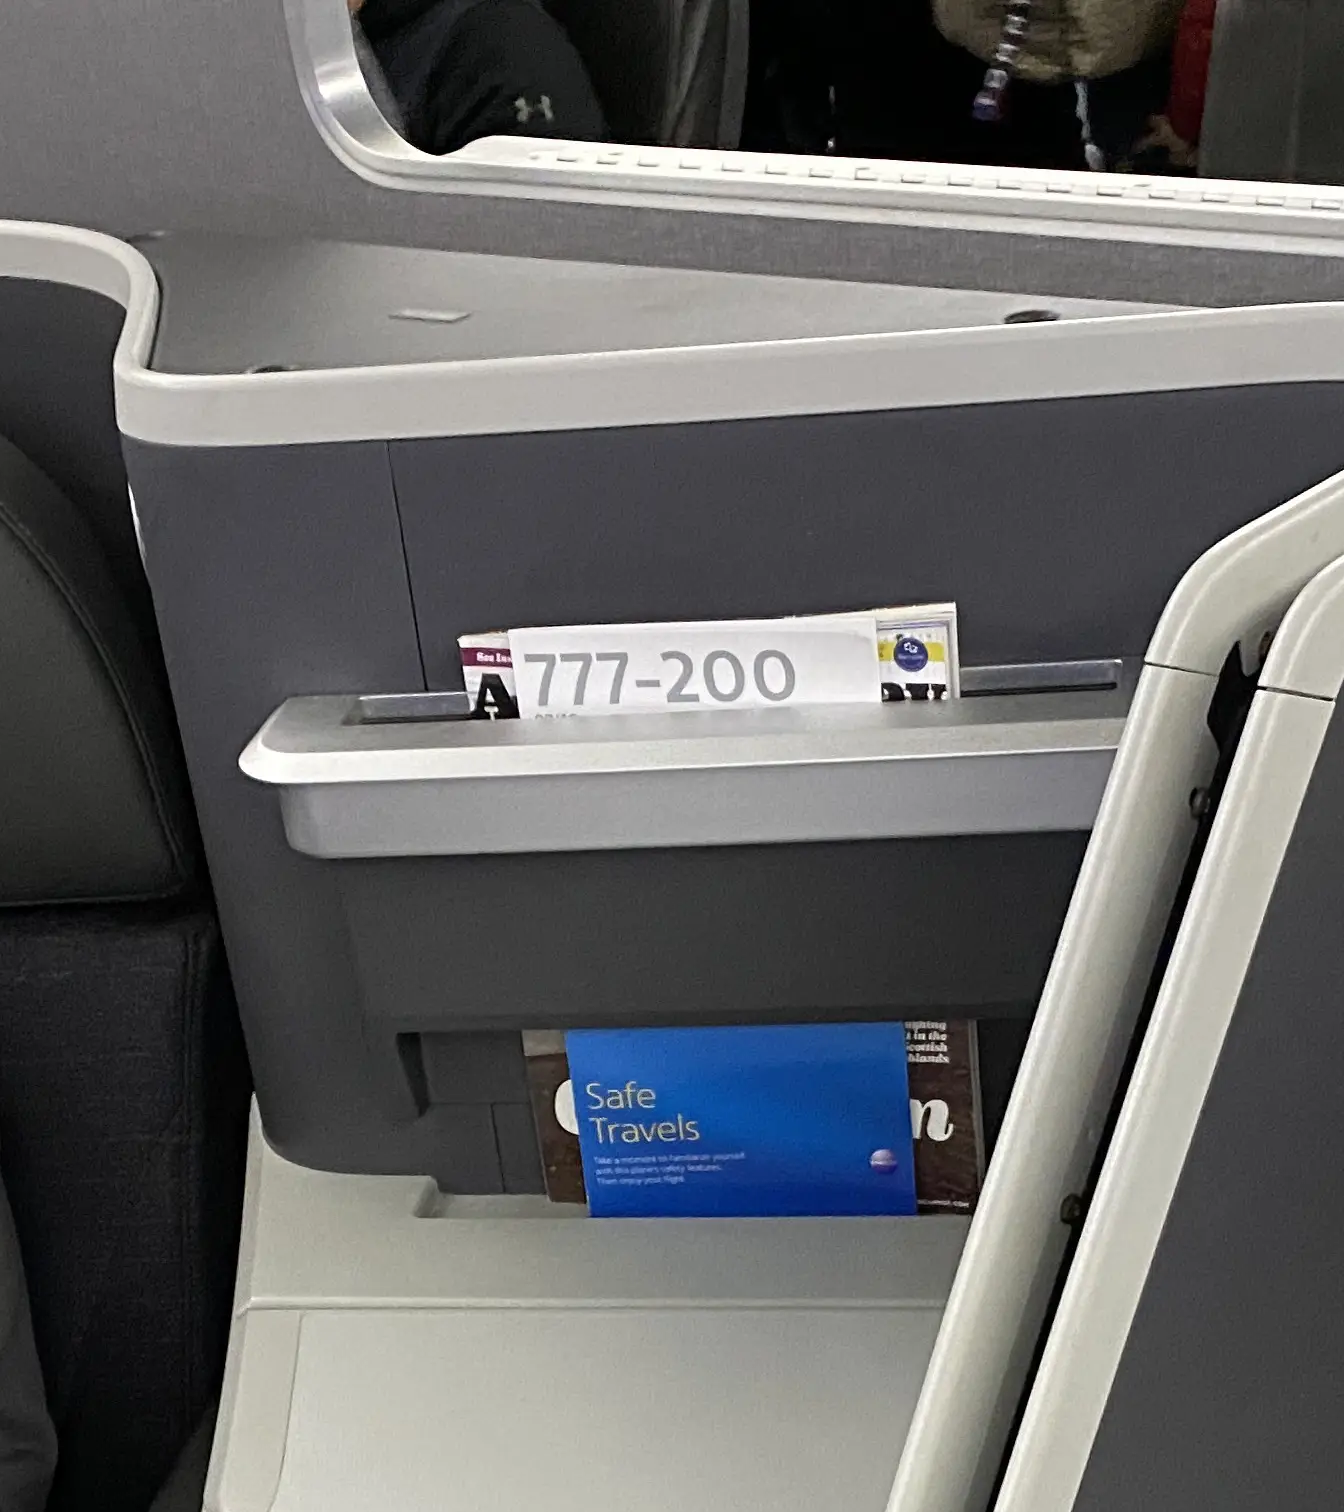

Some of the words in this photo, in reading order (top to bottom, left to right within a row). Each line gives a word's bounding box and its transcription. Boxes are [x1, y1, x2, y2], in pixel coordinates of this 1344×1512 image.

[524, 649, 796, 706] 777-200
[585, 1081, 656, 1110] Safe
[588, 1113, 700, 1144] Travels
